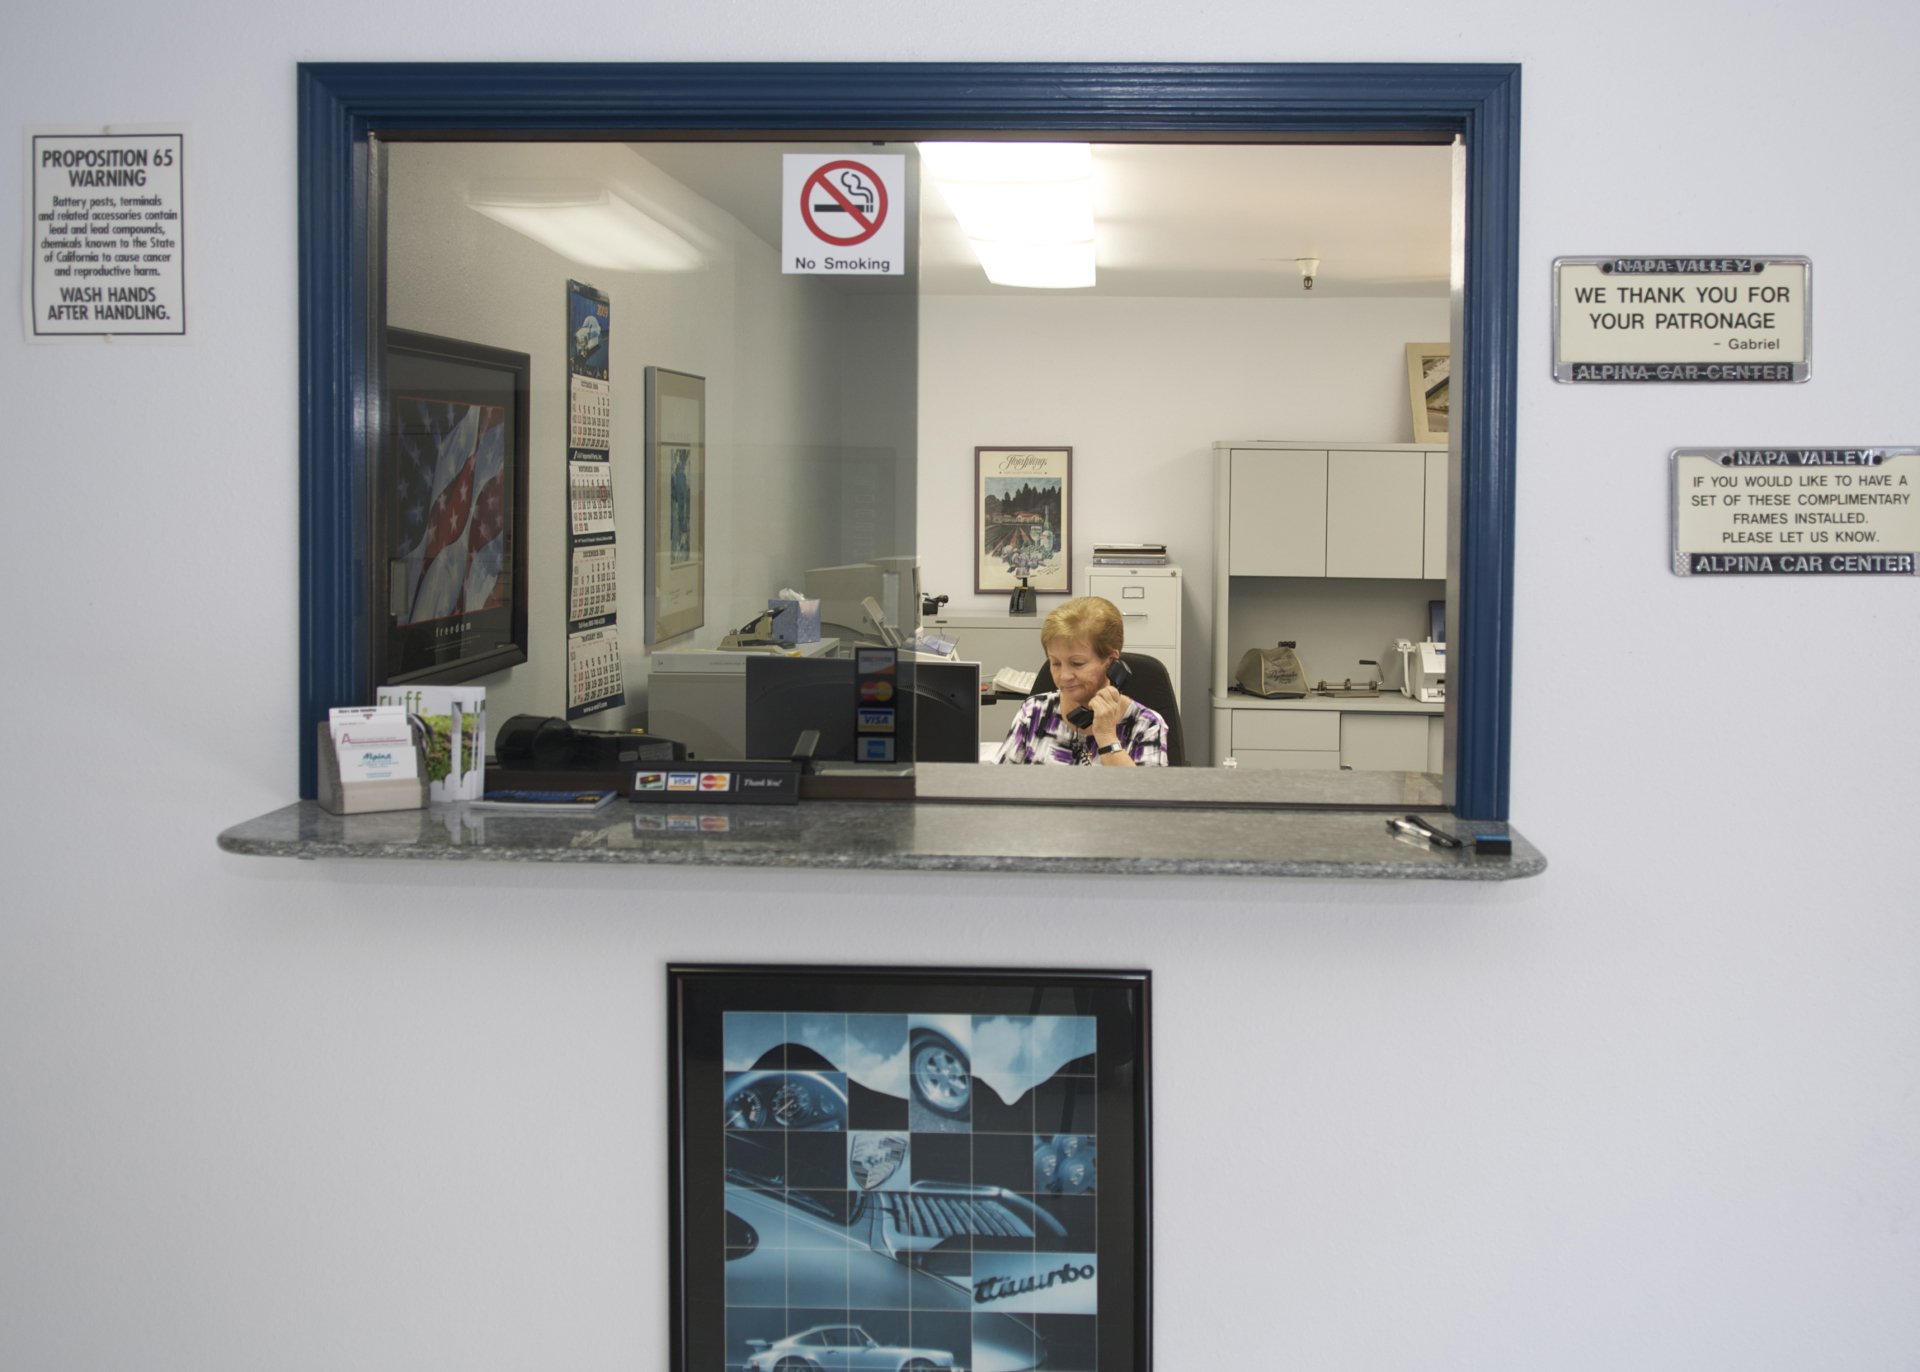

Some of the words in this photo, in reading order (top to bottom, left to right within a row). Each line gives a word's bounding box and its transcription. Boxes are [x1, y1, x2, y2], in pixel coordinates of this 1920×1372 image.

[42, 150, 147, 167] PROPOSITION
[153, 149, 173, 166] 65
[69, 169, 146, 187] WARNING
[53, 196, 86, 209] Battery
[90, 195, 116, 209] posts,
[120, 195, 162, 206] terminals
[39, 210, 54, 221] and
[57, 210, 88, 220] related
[92, 210, 141, 220] accessories
[145, 210, 177, 220] contain
[49, 224, 67, 234] lead
[71, 224, 87, 234] and
[90, 224, 109, 234] lead
[113, 223, 165, 237] compounds,
[41, 238, 82, 249] chemicals
[85, 238, 116, 248] known
[120, 238, 129, 248] to
[133, 237, 147, 248] the
[150, 237, 175, 248] State
[44, 252, 53, 263] of
[56, 251, 99, 262] California
[102, 252, 111, 262] to
[115, 253, 140, 262] cause
[143, 254, 171, 262] cancer
[796, 257, 815, 269] No
[824, 257, 890, 272] Smoking
[1619, 260, 1668, 272] NAPA
[1677, 259, 1749, 272] VALLEY
[55, 266, 70, 276] and
[74, 266, 130, 279] reproductive
[134, 266, 160, 276] harm.
[60, 287, 101, 302] WASH
[108, 286, 156, 302] HANDS
[1575, 288, 1606, 303] WE
[1617, 287, 1685, 303] THANK
[1696, 287, 1736, 303] YOU
[1748, 287, 1790, 303] FOR
[48, 305, 88, 320] AFTER
[95, 304, 170, 320] HANDLING.
[1590, 313, 1644, 330] YOUR
[1656, 313, 1775, 329] PATRONAGE
[1728, 338, 1780, 350] Gabriel
[1576, 366, 1649, 380] ALPINA
[1656, 365, 1699, 379] CAR
[1707, 365, 1789, 379] CENTER
[1738, 451, 1789, 465] NAPA
[1798, 451, 1870, 465] VALLEY
[1693, 477, 1704, 487] IF
[1711, 476, 1737, 487] YOU
[1744, 476, 1792, 487] WOULD
[1800, 476, 1827, 486] LIKE
[1835, 476, 1852, 486] TO
[1858, 475, 1892, 486] HAVE
[1899, 475, 1907, 486] A
[1691, 496, 1716, 506] SET
[1723, 495, 1741, 506] OF
[1749, 495, 1790, 505] THESE
[1798, 494, 1910, 505] COMPLIMENTARY
[1734, 513, 1788, 524] FRAMES
[1795, 513, 1869, 524] INSTALLED.
[1722, 532, 1772, 543] PLEASE
[1780, 532, 1804, 543] LET
[1810, 532, 1828, 543] US
[1836, 531, 1879, 543] KNOW.
[1697, 556, 1771, 572] ALPINA
[1780, 556, 1822, 572] CAR
[1830, 556, 1911, 572] CENTER
[435, 622, 471, 637] freedom
[864, 716, 888, 724] VISA
